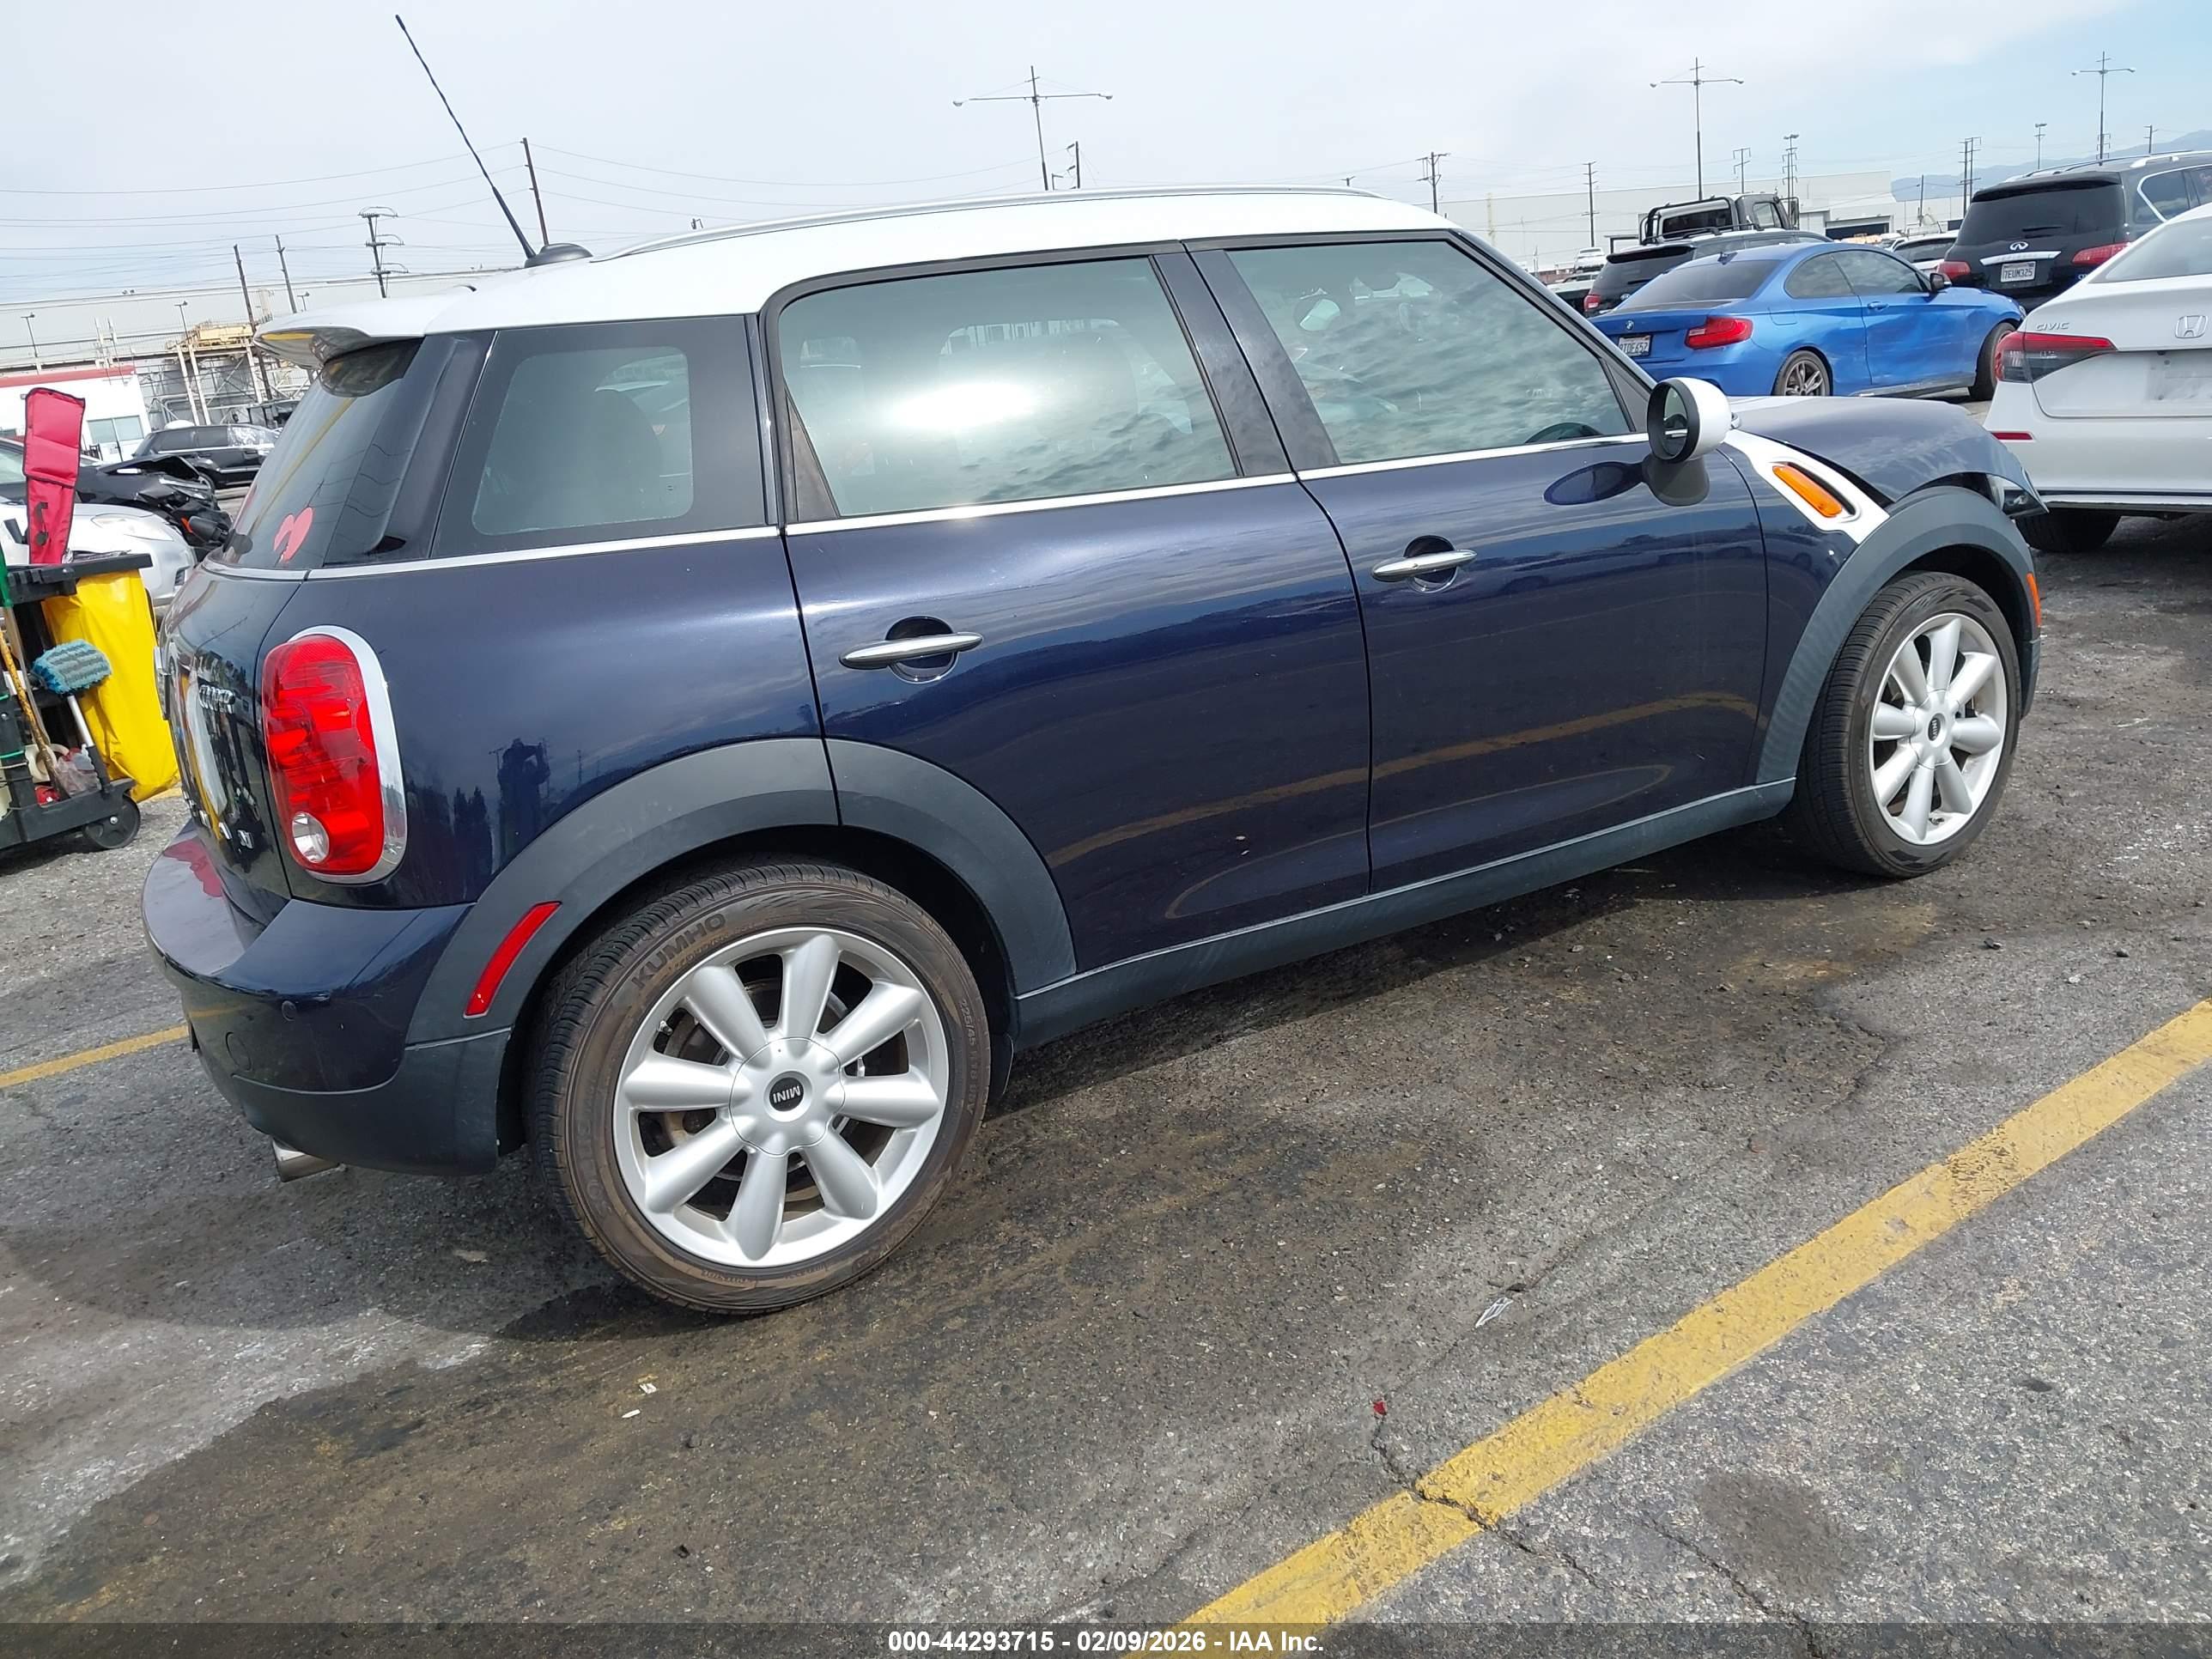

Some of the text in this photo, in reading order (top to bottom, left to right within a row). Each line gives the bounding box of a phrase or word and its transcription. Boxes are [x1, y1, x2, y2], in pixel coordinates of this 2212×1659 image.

[2035, 322, 2069, 331] CIVIC
[631, 913, 726, 988] KUMHO
[773, 1085, 801, 1103] MINI
